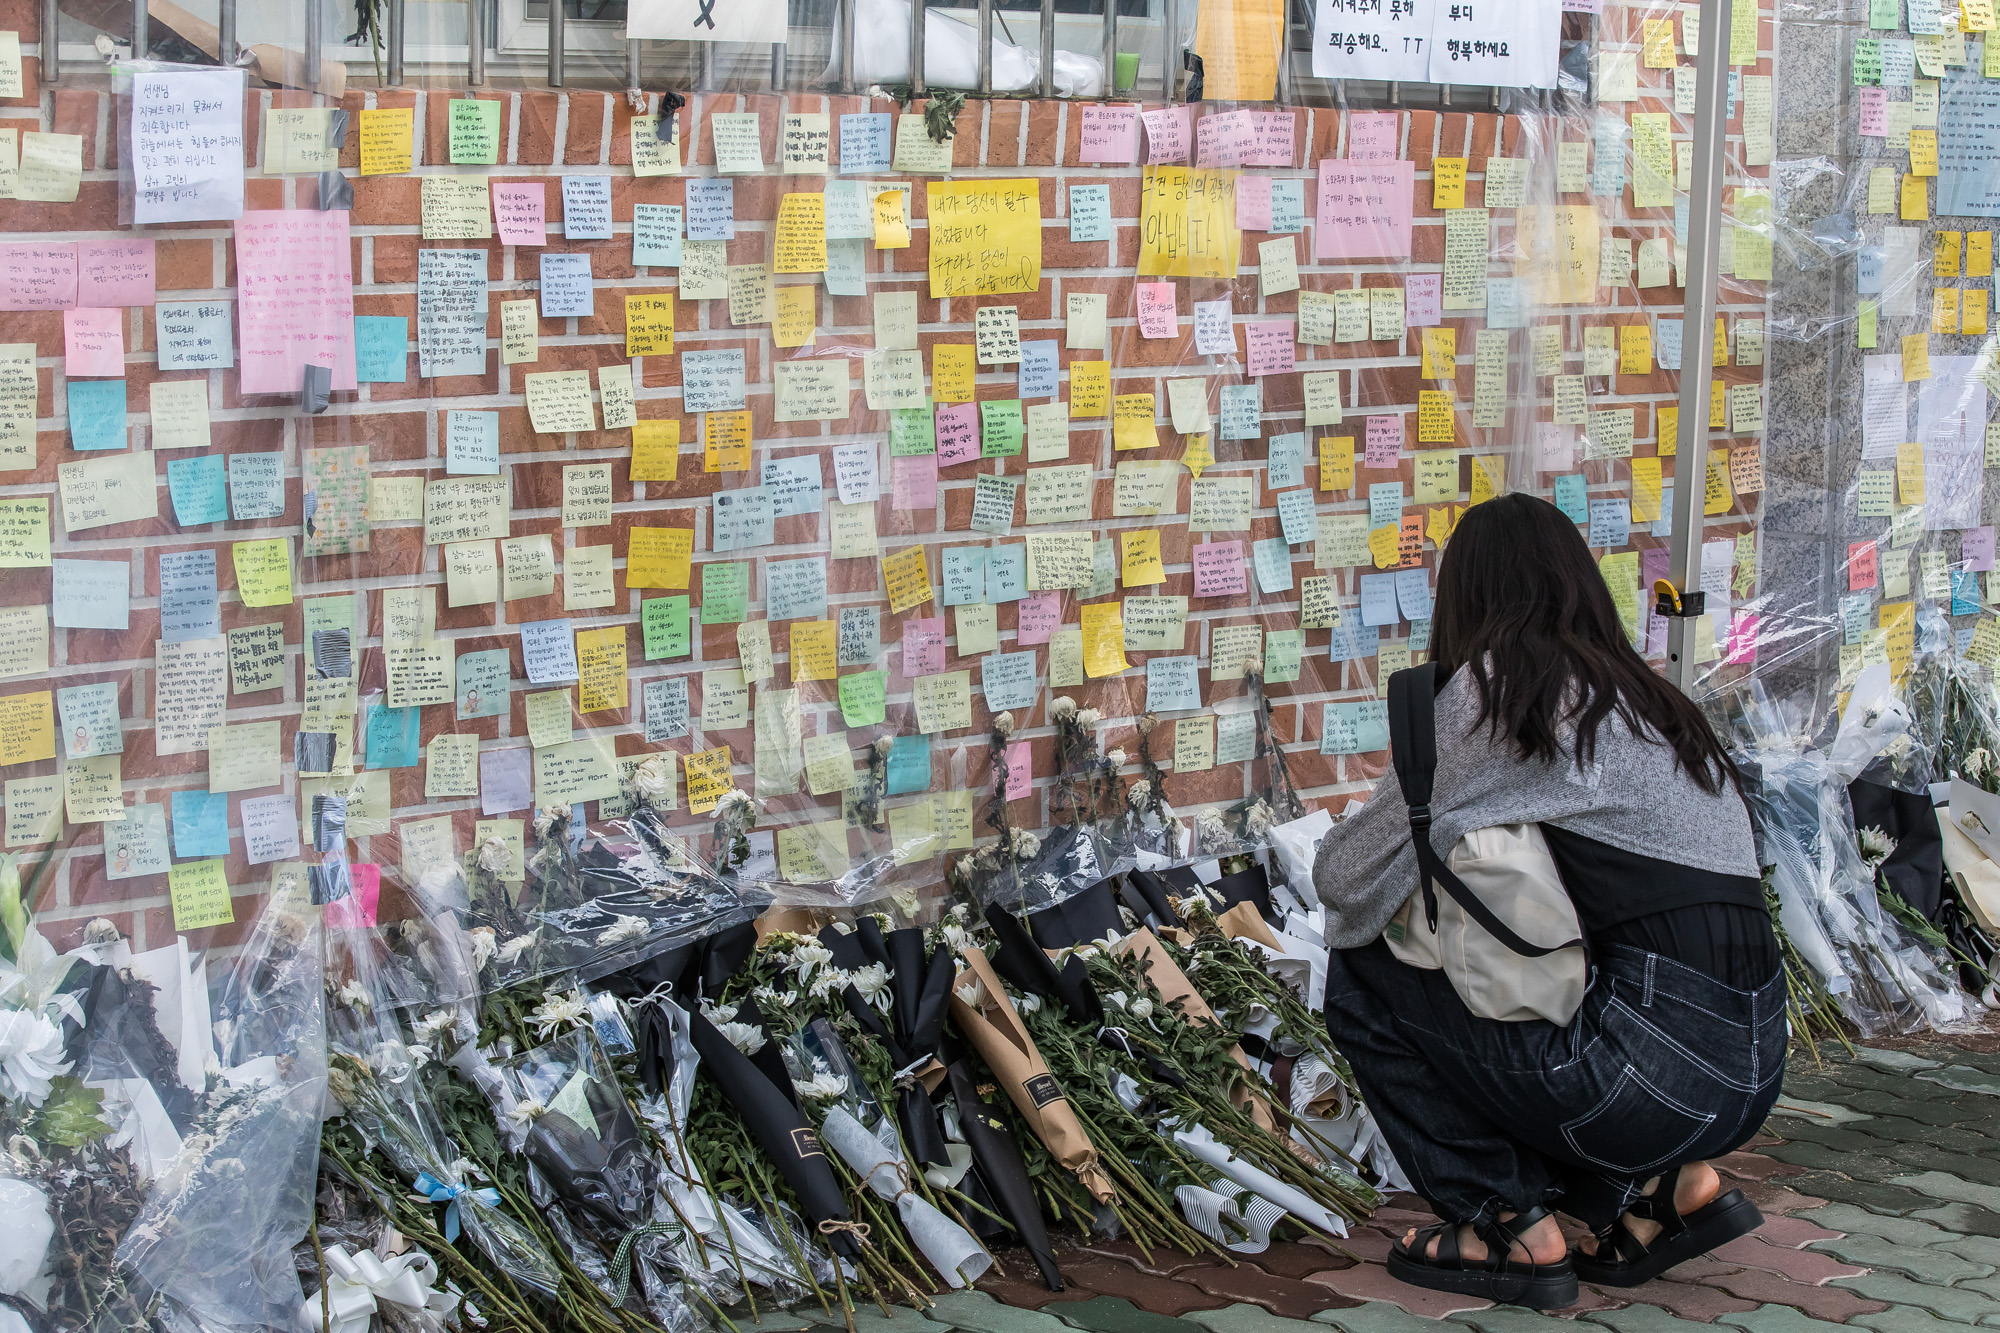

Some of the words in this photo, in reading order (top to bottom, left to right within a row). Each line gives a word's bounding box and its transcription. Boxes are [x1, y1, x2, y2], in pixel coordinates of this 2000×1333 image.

[1390, 0, 1413, 21] 못해
[1449, 4, 1473, 21] 부디
[1329, 33, 1388, 55] 죄송해요..
[1447, 40, 1510, 61] 행복하세요
[143, 82, 169, 99] 선생님
[139, 104, 186, 117] 지켜드리지
[193, 100, 222, 113] 못해서
[141, 121, 191, 135] 죄송합니다.
[140, 138, 183, 153] 하늘에서는
[190, 135, 217, 149] 힘들어
[142, 155, 159, 167] 말고
[164, 154, 181, 166] 편히
[185, 154, 219, 165] 쉬십시오.
[144, 175, 160, 189] 삼가
[165, 173, 187, 186] 고인의
[1143, 175, 1168, 197] 그건
[1174, 173, 1206, 201] 당신의
[1209, 175, 1235, 204] 잘못이
[144, 189, 166, 204] 명복을
[935, 191, 960, 214] 내가
[969, 190, 999, 215] 당신이
[1348, 194, 1363, 206] 함께
[1147, 209, 1218, 260] 아닙니다.
[107, 249, 124, 258] 명복을
[934, 254, 977, 272] 누구라도
[980, 247, 1010, 268] 당신이
[168, 339, 195, 349] 지켜주지
[62, 466, 85, 479] 선생님
[67, 482, 98, 492] 지켜드리지
[429, 485, 446, 495] 선생님
[450, 484, 460, 495] 너무
[429, 503, 435, 511] 그
[457, 500, 467, 509] 부디
[429, 515, 455, 525] 바랍니다.
[441, 530, 455, 540] 고인의
[457, 527, 471, 538] 명복을
[452, 550, 465, 560] 삼가
[467, 550, 484, 559] 고인의
[454, 564, 471, 575] 명복을
[843, 609, 854, 620] 삼가
[855, 607, 870, 618] 고인의
[841, 620, 856, 632] 명복을
[231, 632, 266, 646] 선생님께서
[231, 646, 249, 660] 얼마나
[250, 645, 267, 656] 힘들고
[67, 766, 91, 776] 선생님.
[69, 777, 82, 787] 부디
[70, 787, 84, 797] 편히
[199, 864, 214, 874] 선생님
[174, 881, 191, 891] 우리가
[195, 878, 206, 888] 너무
